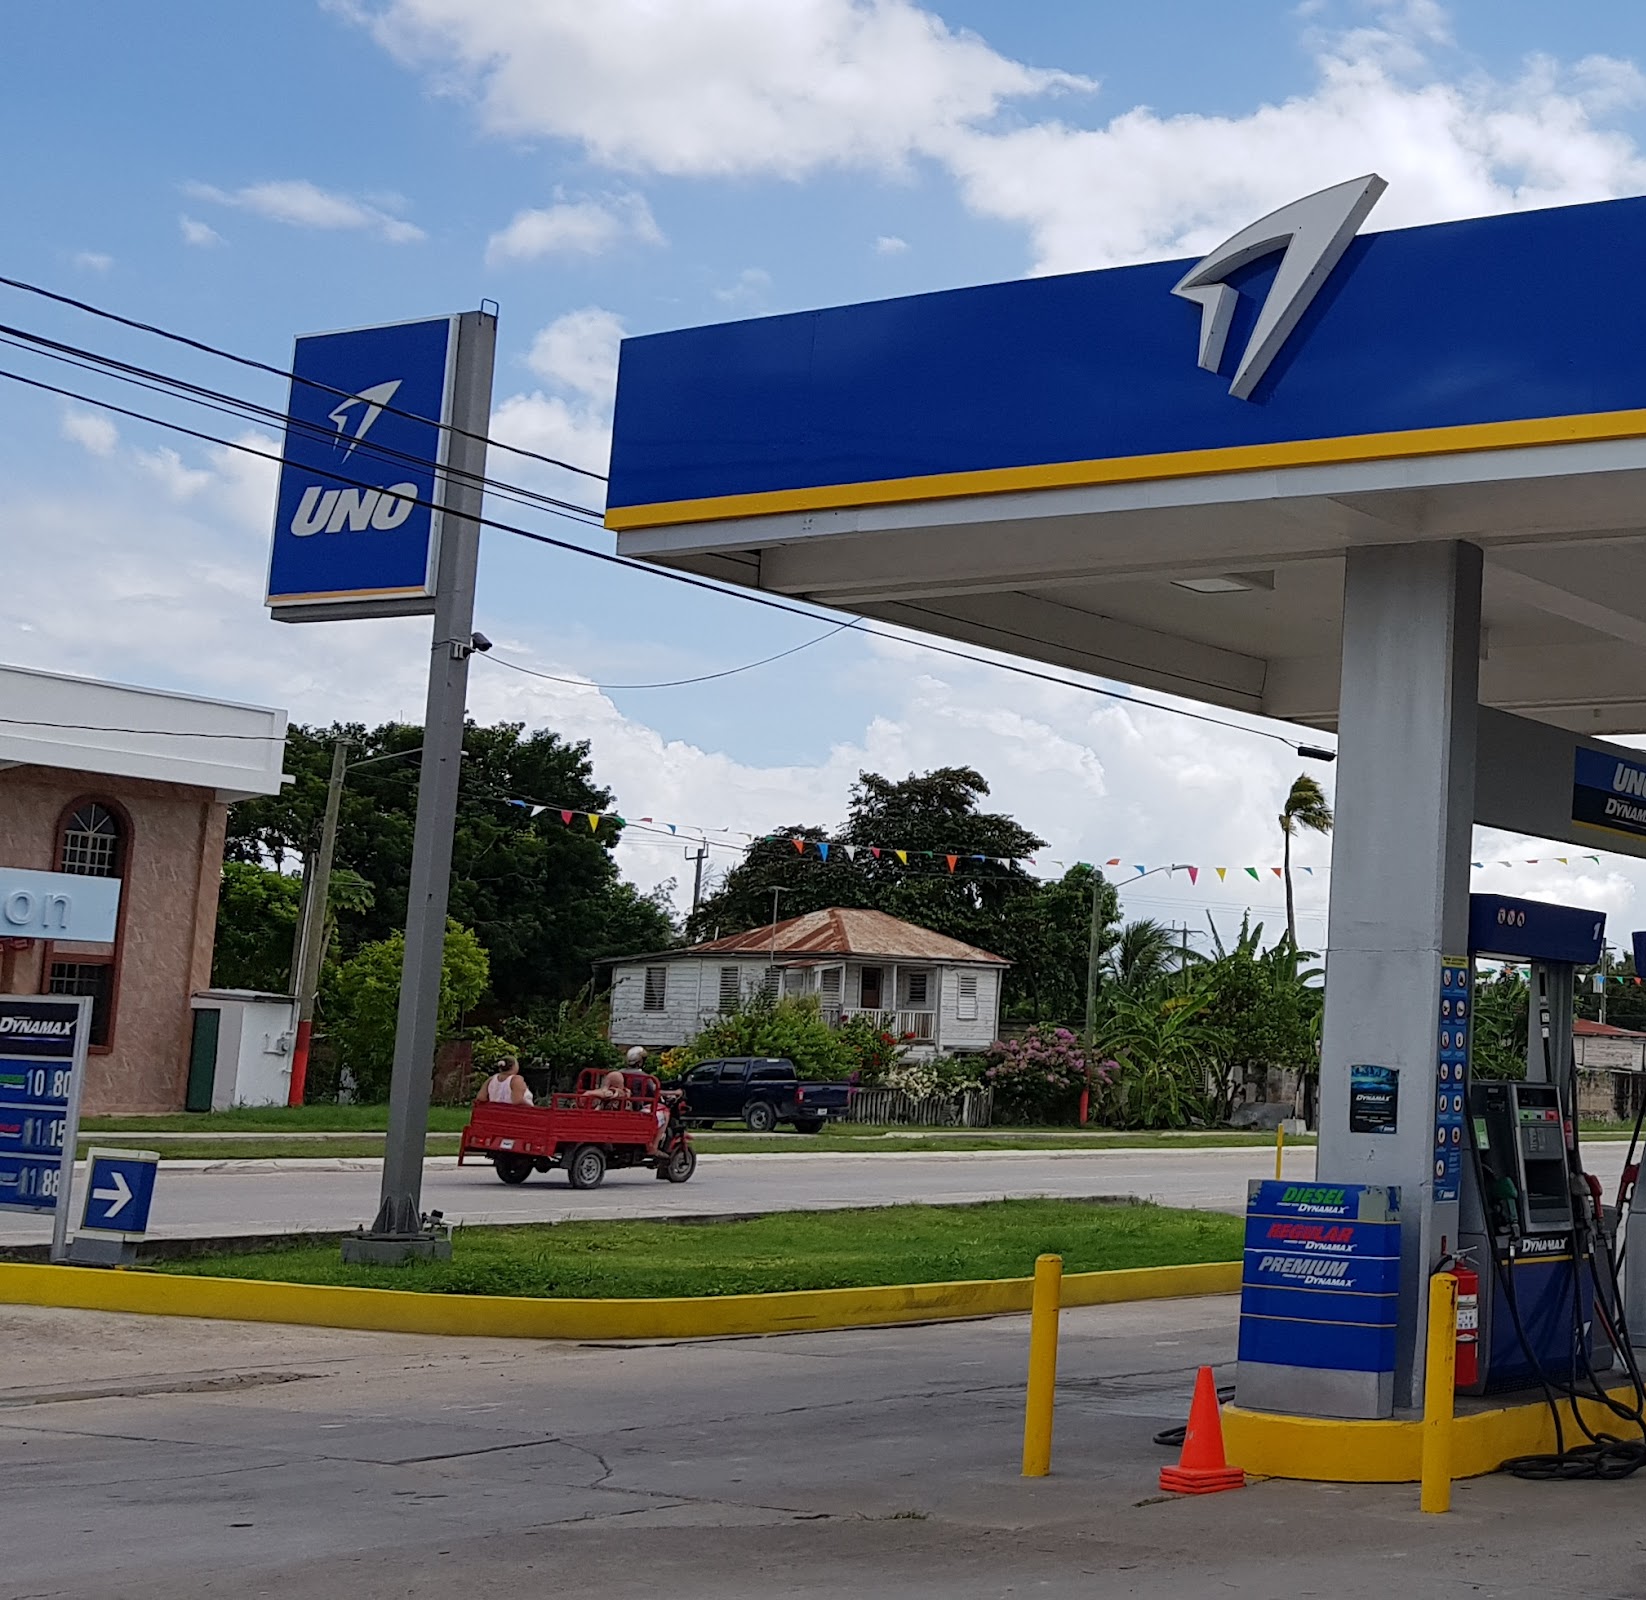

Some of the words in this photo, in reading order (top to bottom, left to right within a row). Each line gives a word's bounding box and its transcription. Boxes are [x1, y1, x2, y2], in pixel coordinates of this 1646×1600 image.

[290, 482, 418, 536] UNO
[4, 890, 72, 929] on
[1593, 922, 1601, 940] 1
[0, 1016, 77, 1036] DYNAMAX
[1282, 1187, 1347, 1205] DIESEL
[1298, 1203, 1349, 1214] DYNAMAX
[1266, 1223, 1355, 1243] REGULAR
[1305, 1240, 1357, 1252] DYNAMAX
[1258, 1256, 1350, 1277] PREMIUM
[1304, 1275, 1356, 1287] DYNAMAX
